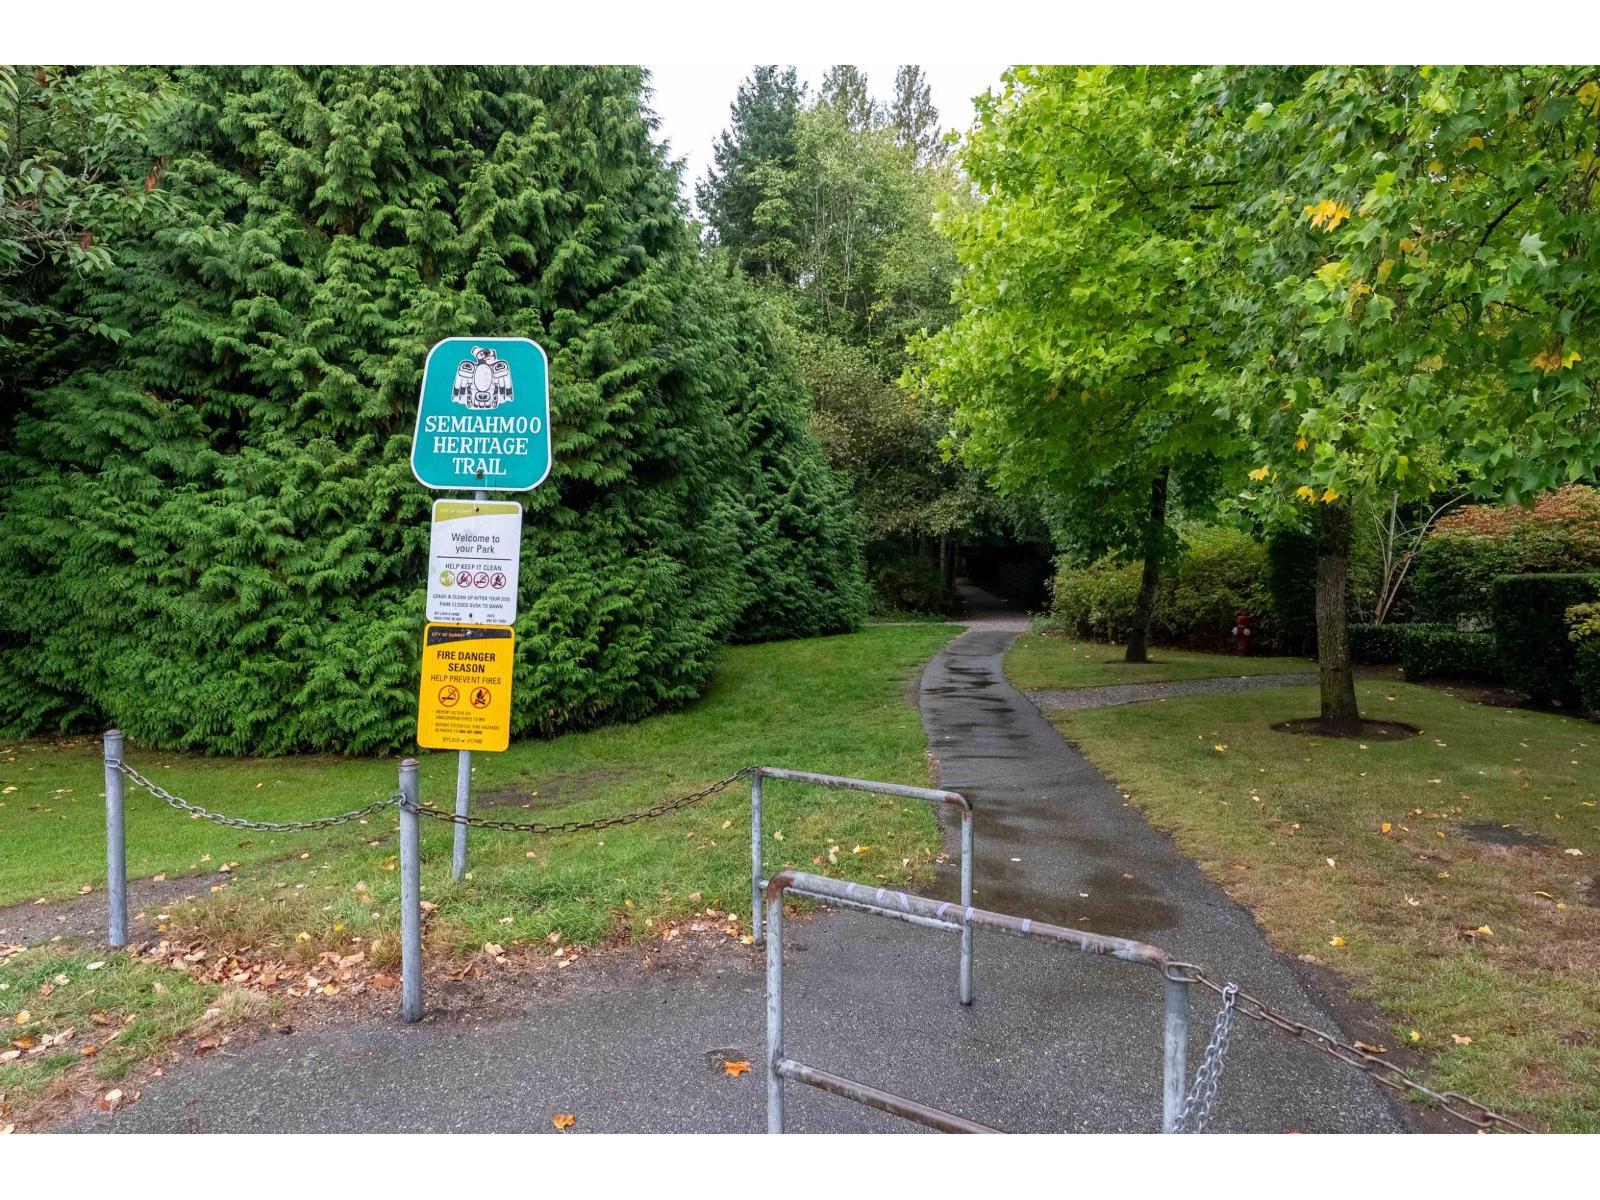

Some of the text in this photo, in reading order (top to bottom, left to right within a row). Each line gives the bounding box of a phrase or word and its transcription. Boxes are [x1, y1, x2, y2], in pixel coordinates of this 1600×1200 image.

[424, 415, 542, 434] SEMIAHMOO
[432, 436, 529, 455] HERITAGE
[452, 457, 507, 476] TRAIL
[451, 533, 500, 543] Welcome to
[455, 544, 495, 554] your Park
[460, 563, 475, 571] KEEP
[437, 650, 496, 662] FIRE DANGER
[448, 662, 486, 673] SEASON
[430, 674, 502, 685] HELP PREVENT FIRES
